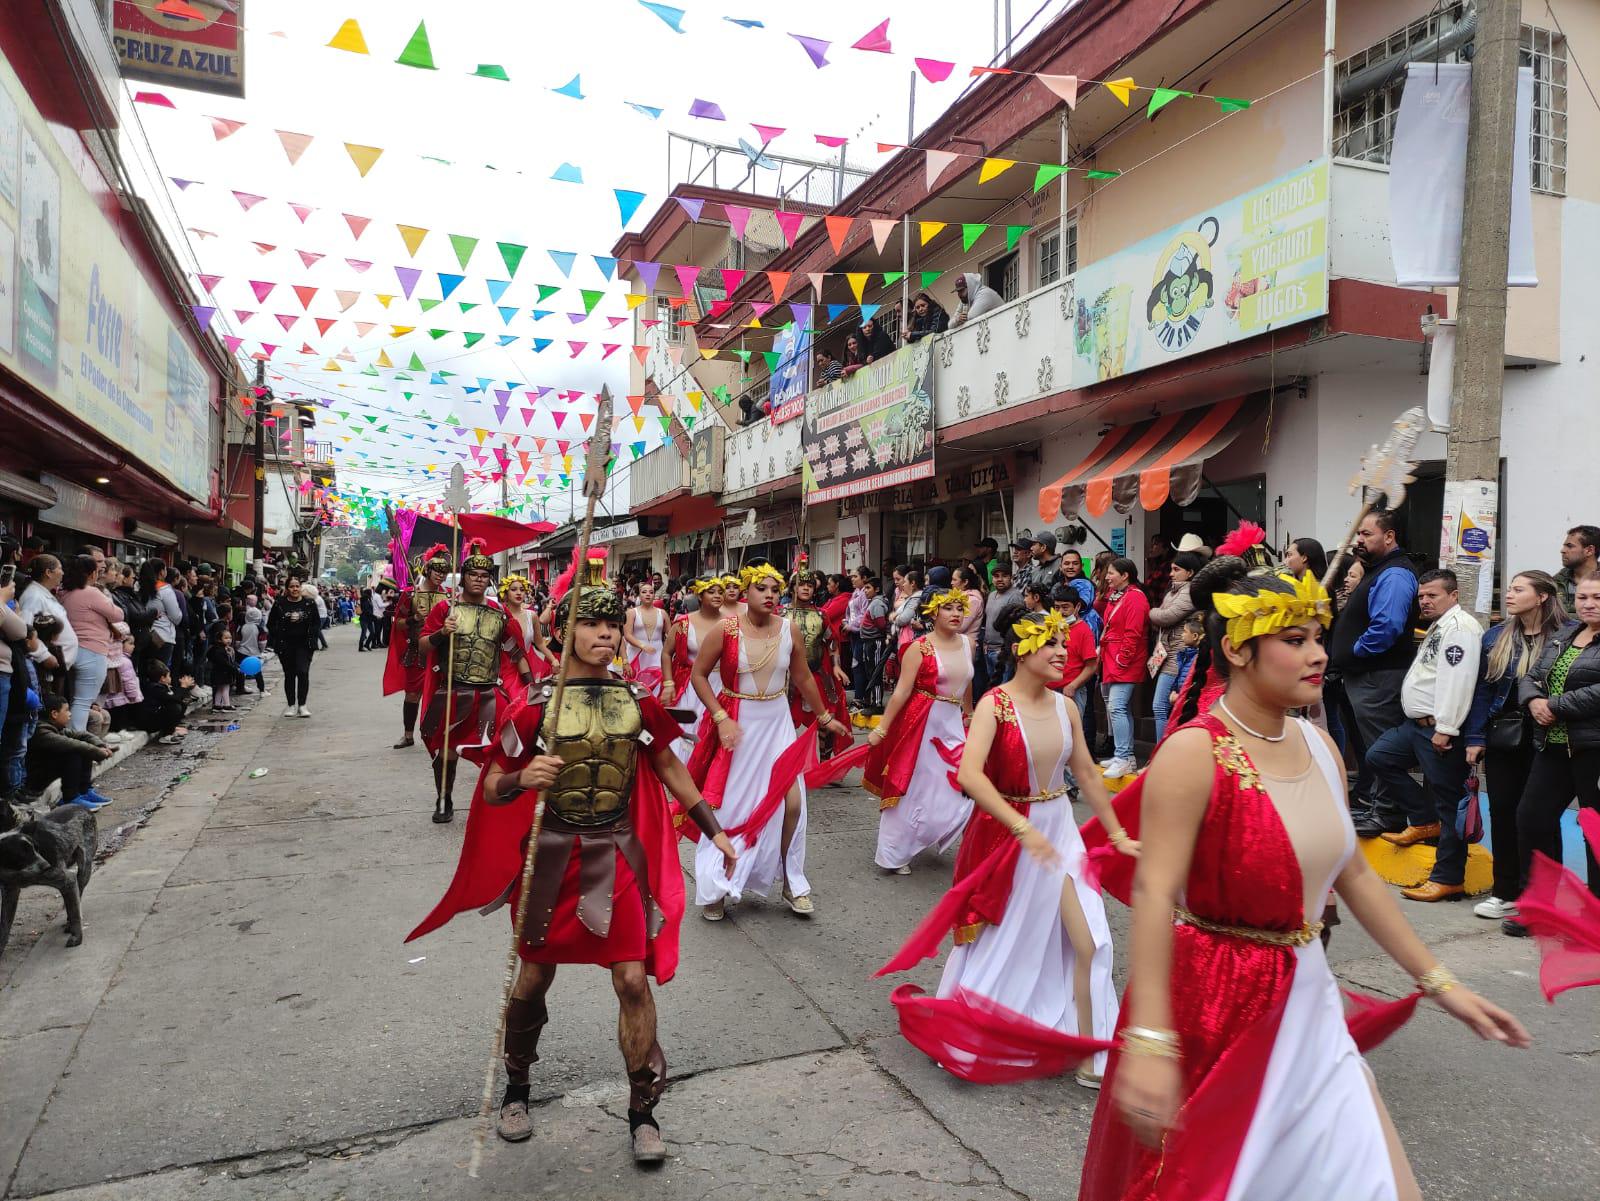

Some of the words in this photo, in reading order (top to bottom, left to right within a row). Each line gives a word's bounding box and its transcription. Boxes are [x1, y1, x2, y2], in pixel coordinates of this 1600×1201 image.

[113, 36, 175, 66] CRUZ
[178, 48, 238, 77] AZUL
[1253, 175, 1315, 224] LICUADOS
[1252, 227, 1313, 275] YOGHURT
[1257, 282, 1307, 321] JUGOS
[1158, 320, 1176, 347] TIO
[1177, 314, 1200, 348] SAM
[844, 487, 913, 511] CARNIRIA
[945, 463, 1009, 494] VAUITA
